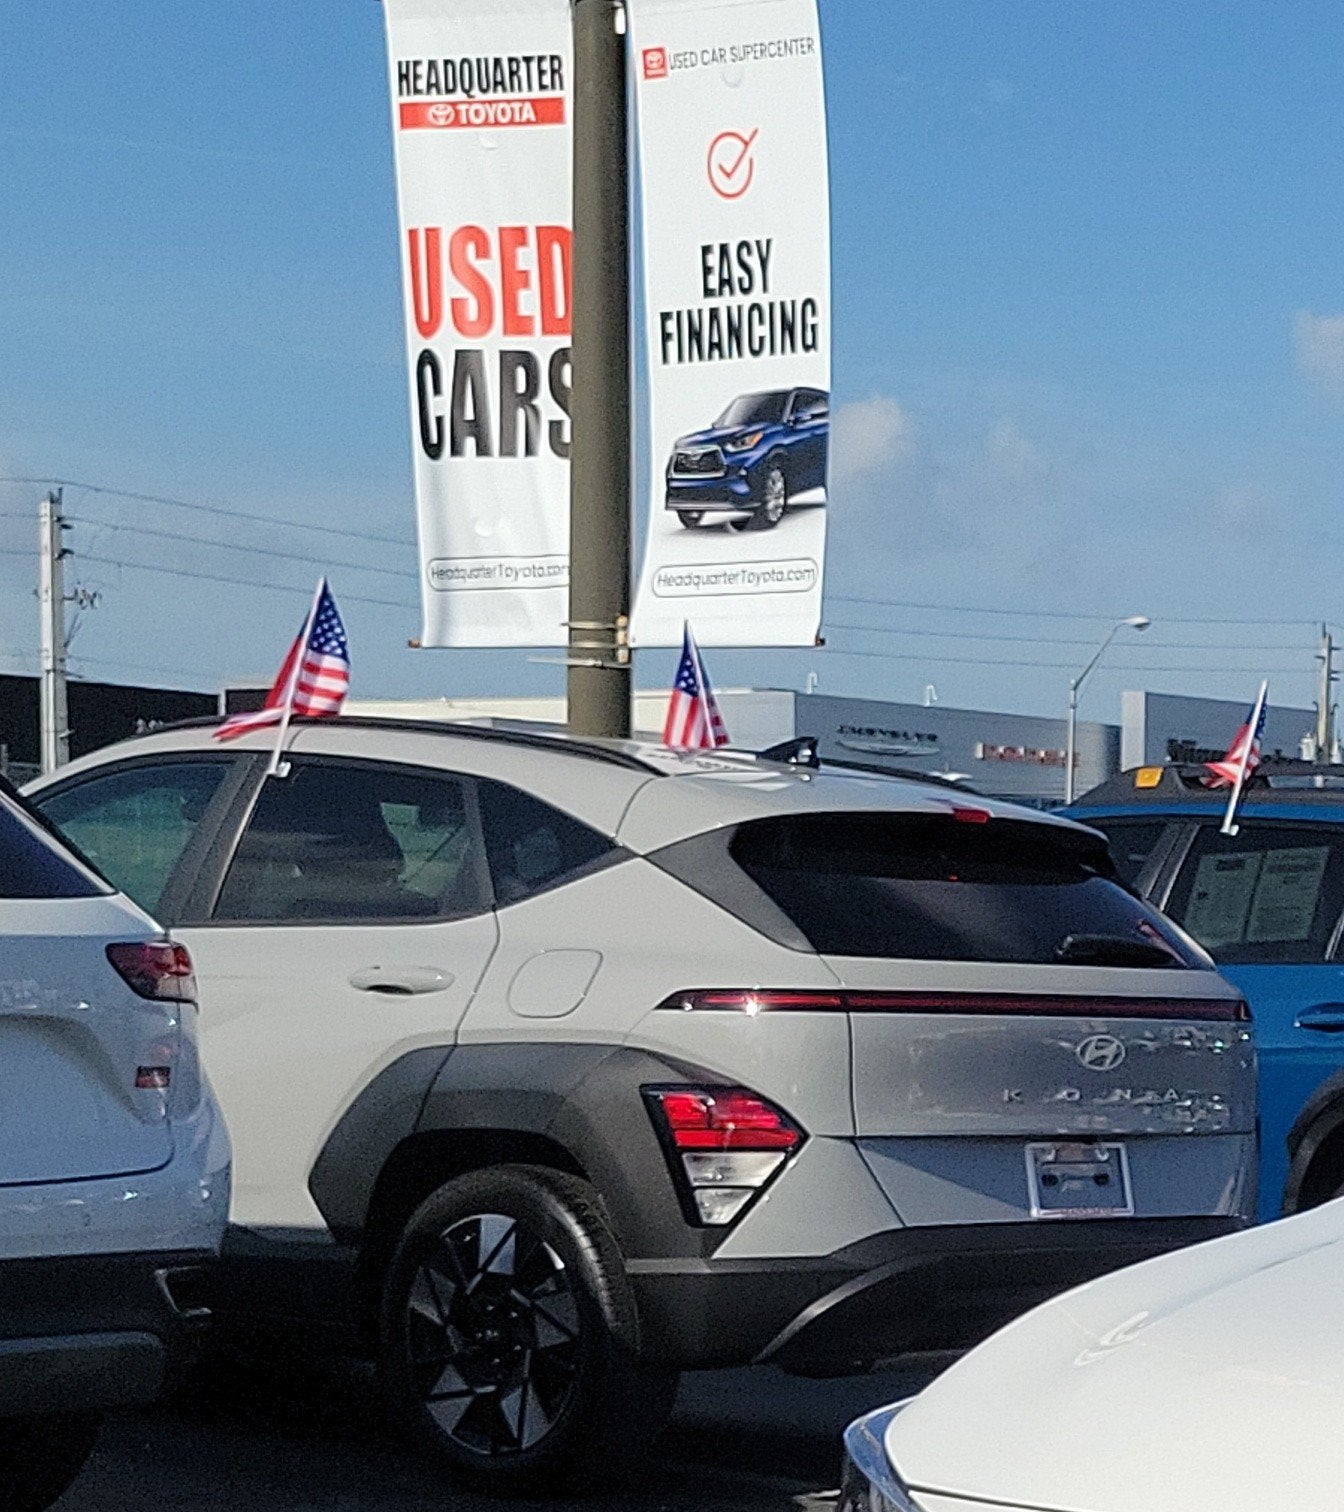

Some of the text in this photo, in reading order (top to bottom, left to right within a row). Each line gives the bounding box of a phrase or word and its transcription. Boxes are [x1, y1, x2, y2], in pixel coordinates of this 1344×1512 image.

[669, 37, 815, 70] USED CAR SUPERCENTER
[398, 55, 564, 98] HEADQUARTER
[457, 101, 536, 125] TOYOTA
[408, 225, 573, 339] USED
[701, 238, 773, 298] EASY
[659, 298, 818, 365] FINANCING
[416, 348, 572, 460] CARS
[658, 567, 814, 590] HeadquarterToyota.com
[1004, 1088, 1180, 1102] KONA
